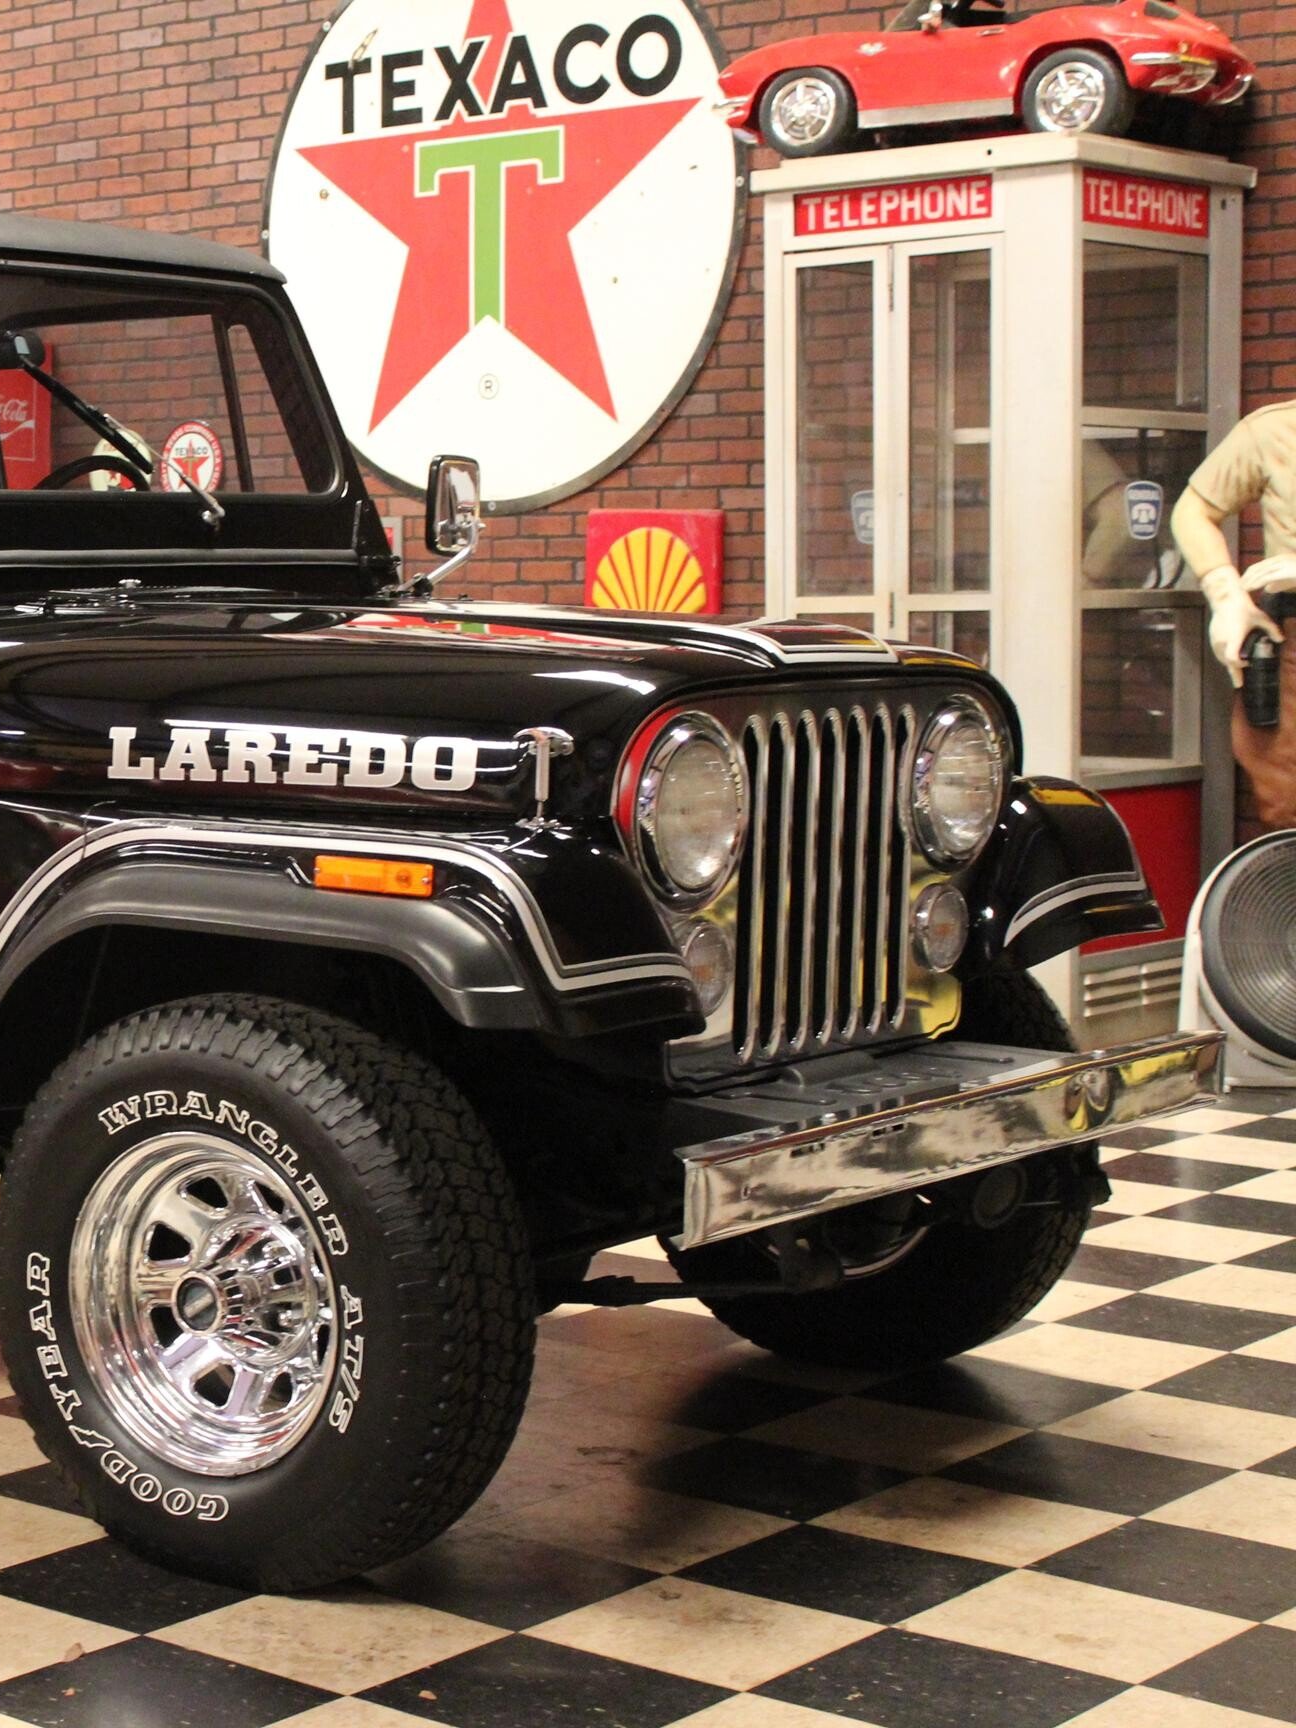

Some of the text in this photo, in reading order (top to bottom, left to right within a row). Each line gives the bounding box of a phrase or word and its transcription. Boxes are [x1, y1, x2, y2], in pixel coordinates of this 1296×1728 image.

[325, 14, 683, 135] TEXACO
[416, 127, 564, 327] T
[803, 179, 989, 232] TELEPHONE
[1085, 176, 1203, 230] TELEPHONE
[107, 726, 478, 792] LAREDO
[98, 1089, 349, 1256] WRANGLER
[26, 1252, 229, 1522] GOODYEAR
[329, 1285, 365, 1434] AT/S
